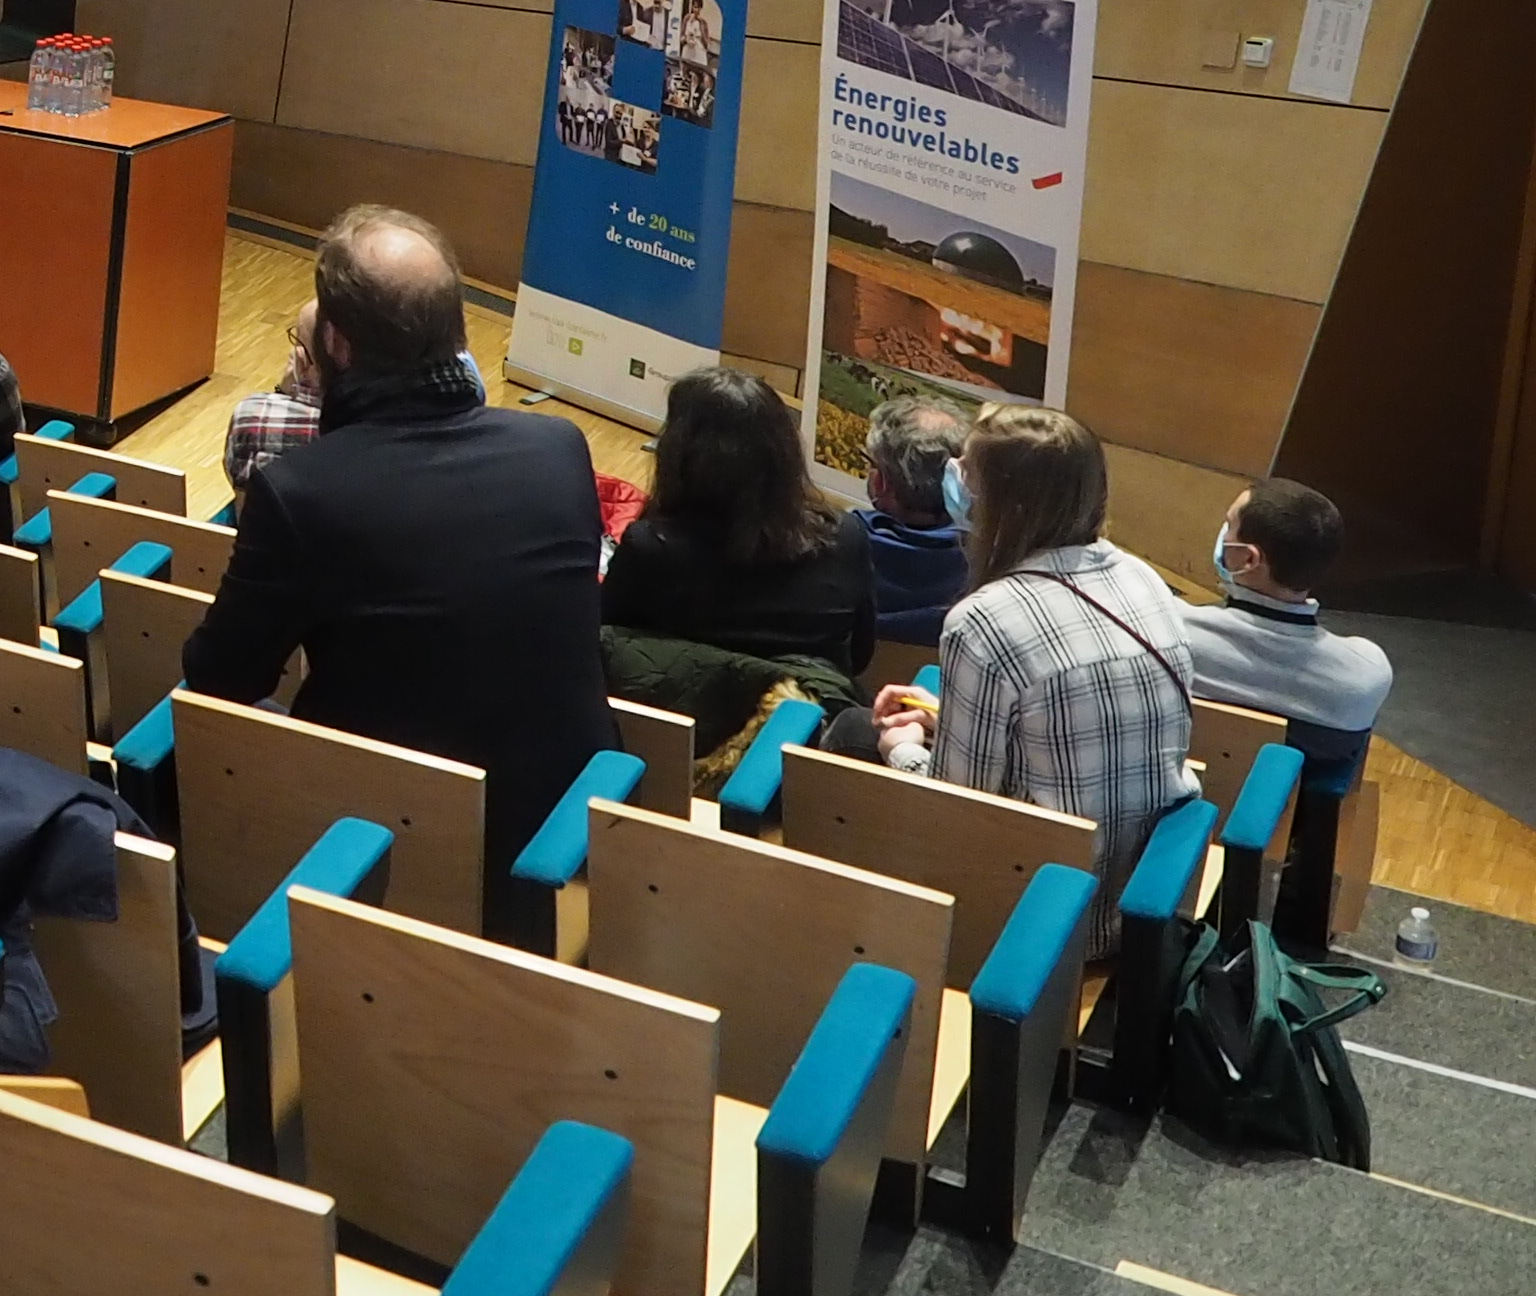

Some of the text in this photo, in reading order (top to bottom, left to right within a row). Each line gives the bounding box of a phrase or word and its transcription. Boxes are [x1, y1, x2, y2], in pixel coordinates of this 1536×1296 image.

[834, 73, 947, 127] Énergies
[832, 134, 1017, 193] Un acteur de référence au service
[833, 109, 1020, 174] renouvelables
[831, 150, 987, 201] de la réussite de votre projet
[606, 225, 696, 270] de confiance
[628, 207, 645, 225] de
[649, 214, 667, 232] 20
[670, 226, 695, 243] ans
